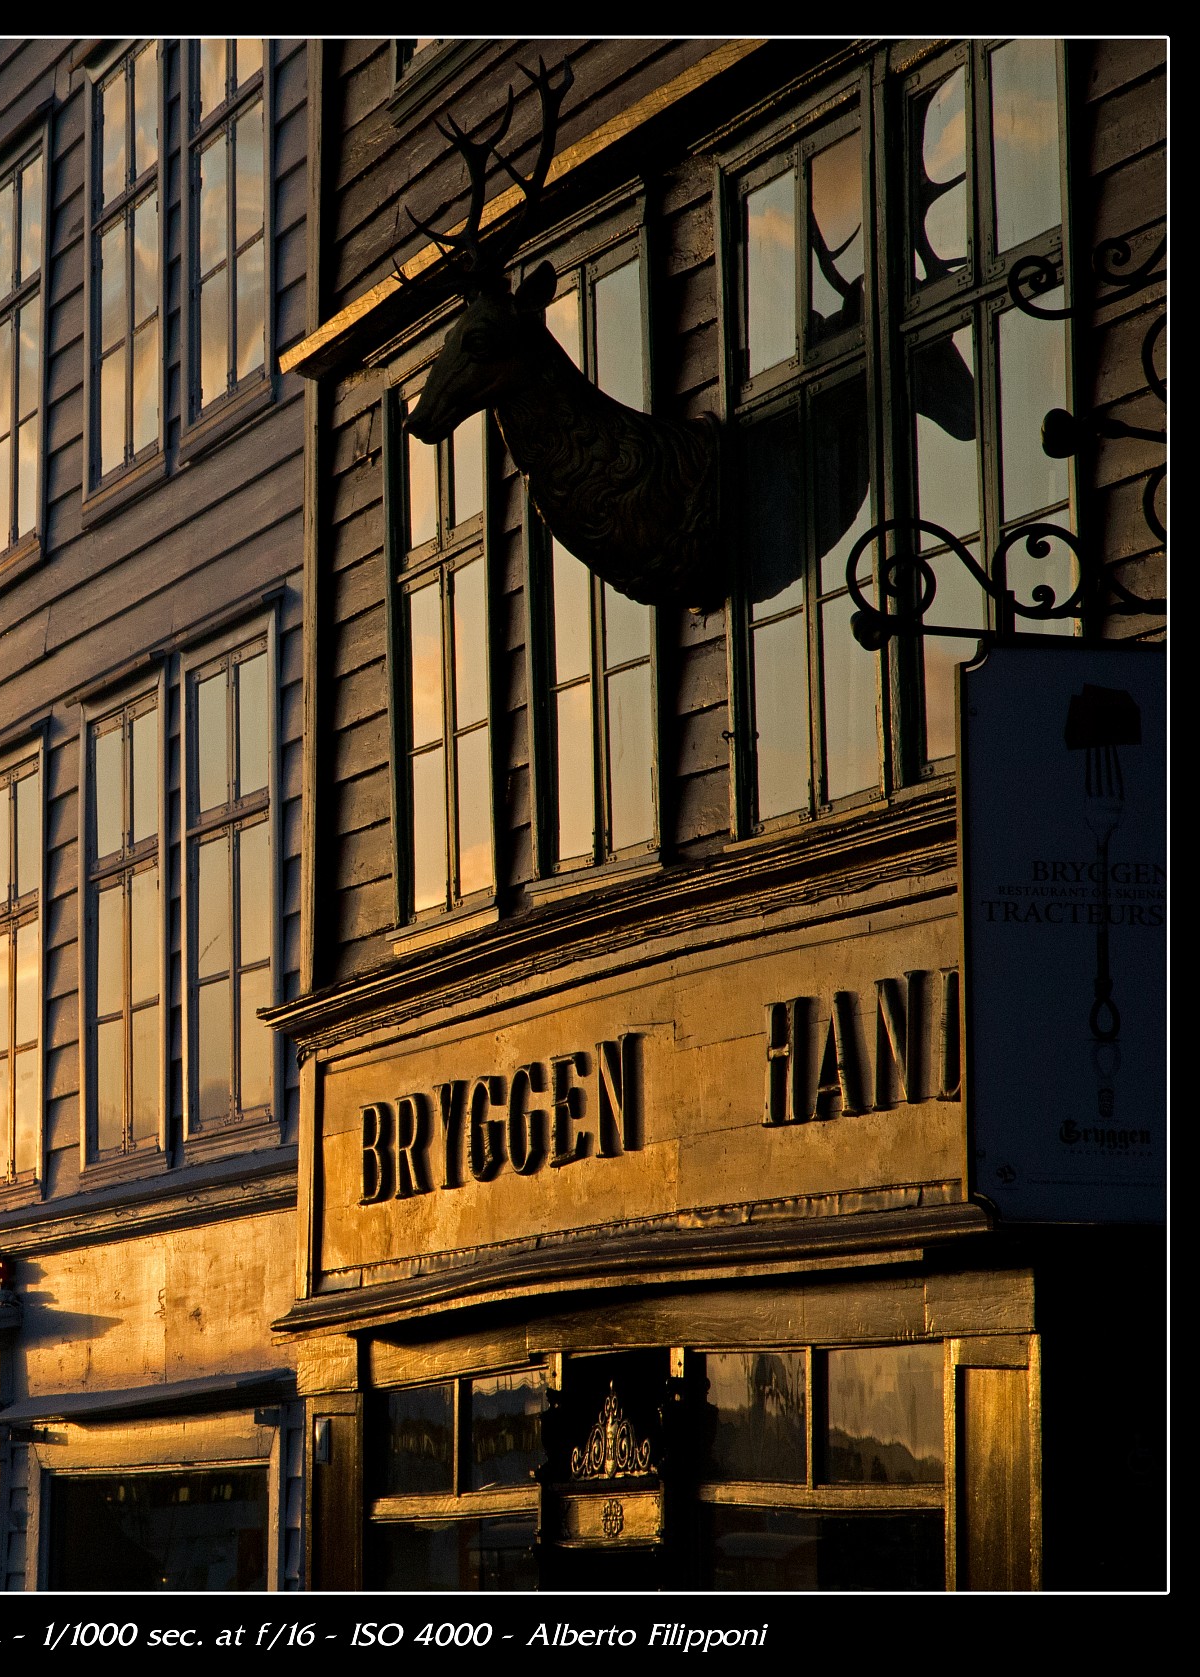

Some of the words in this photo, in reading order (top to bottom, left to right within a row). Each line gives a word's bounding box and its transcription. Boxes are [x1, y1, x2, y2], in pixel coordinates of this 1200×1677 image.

[1032, 860, 1166, 885] BRYGGEN
[998, 885, 1088, 898] RESTAURANT
[980, 900, 1165, 927] TRACTEURS
[358, 1032, 645, 1206] BRYGGEN
